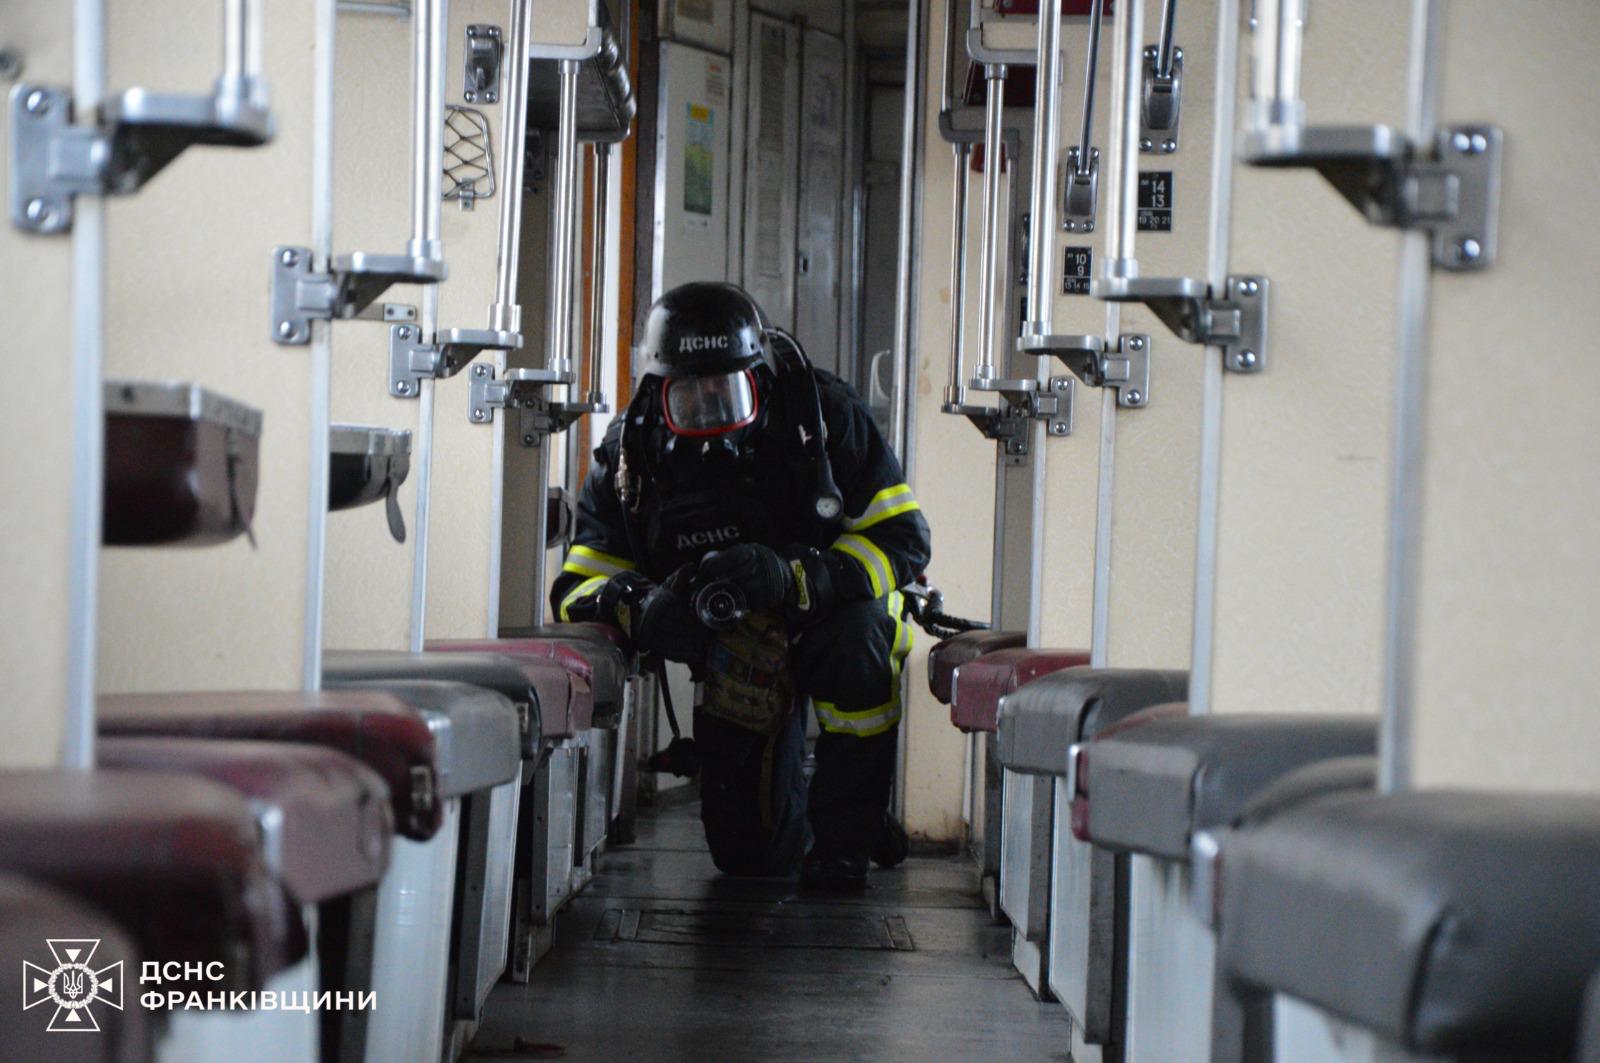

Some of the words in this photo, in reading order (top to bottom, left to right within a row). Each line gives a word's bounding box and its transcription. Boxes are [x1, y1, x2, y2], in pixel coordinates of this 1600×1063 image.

[1151, 180, 1165, 194] 14
[1151, 194, 1165, 208] 13
[1075, 253, 1087, 265] 10
[1077, 266, 1085, 277] 9
[679, 335, 729, 353] ДСНС
